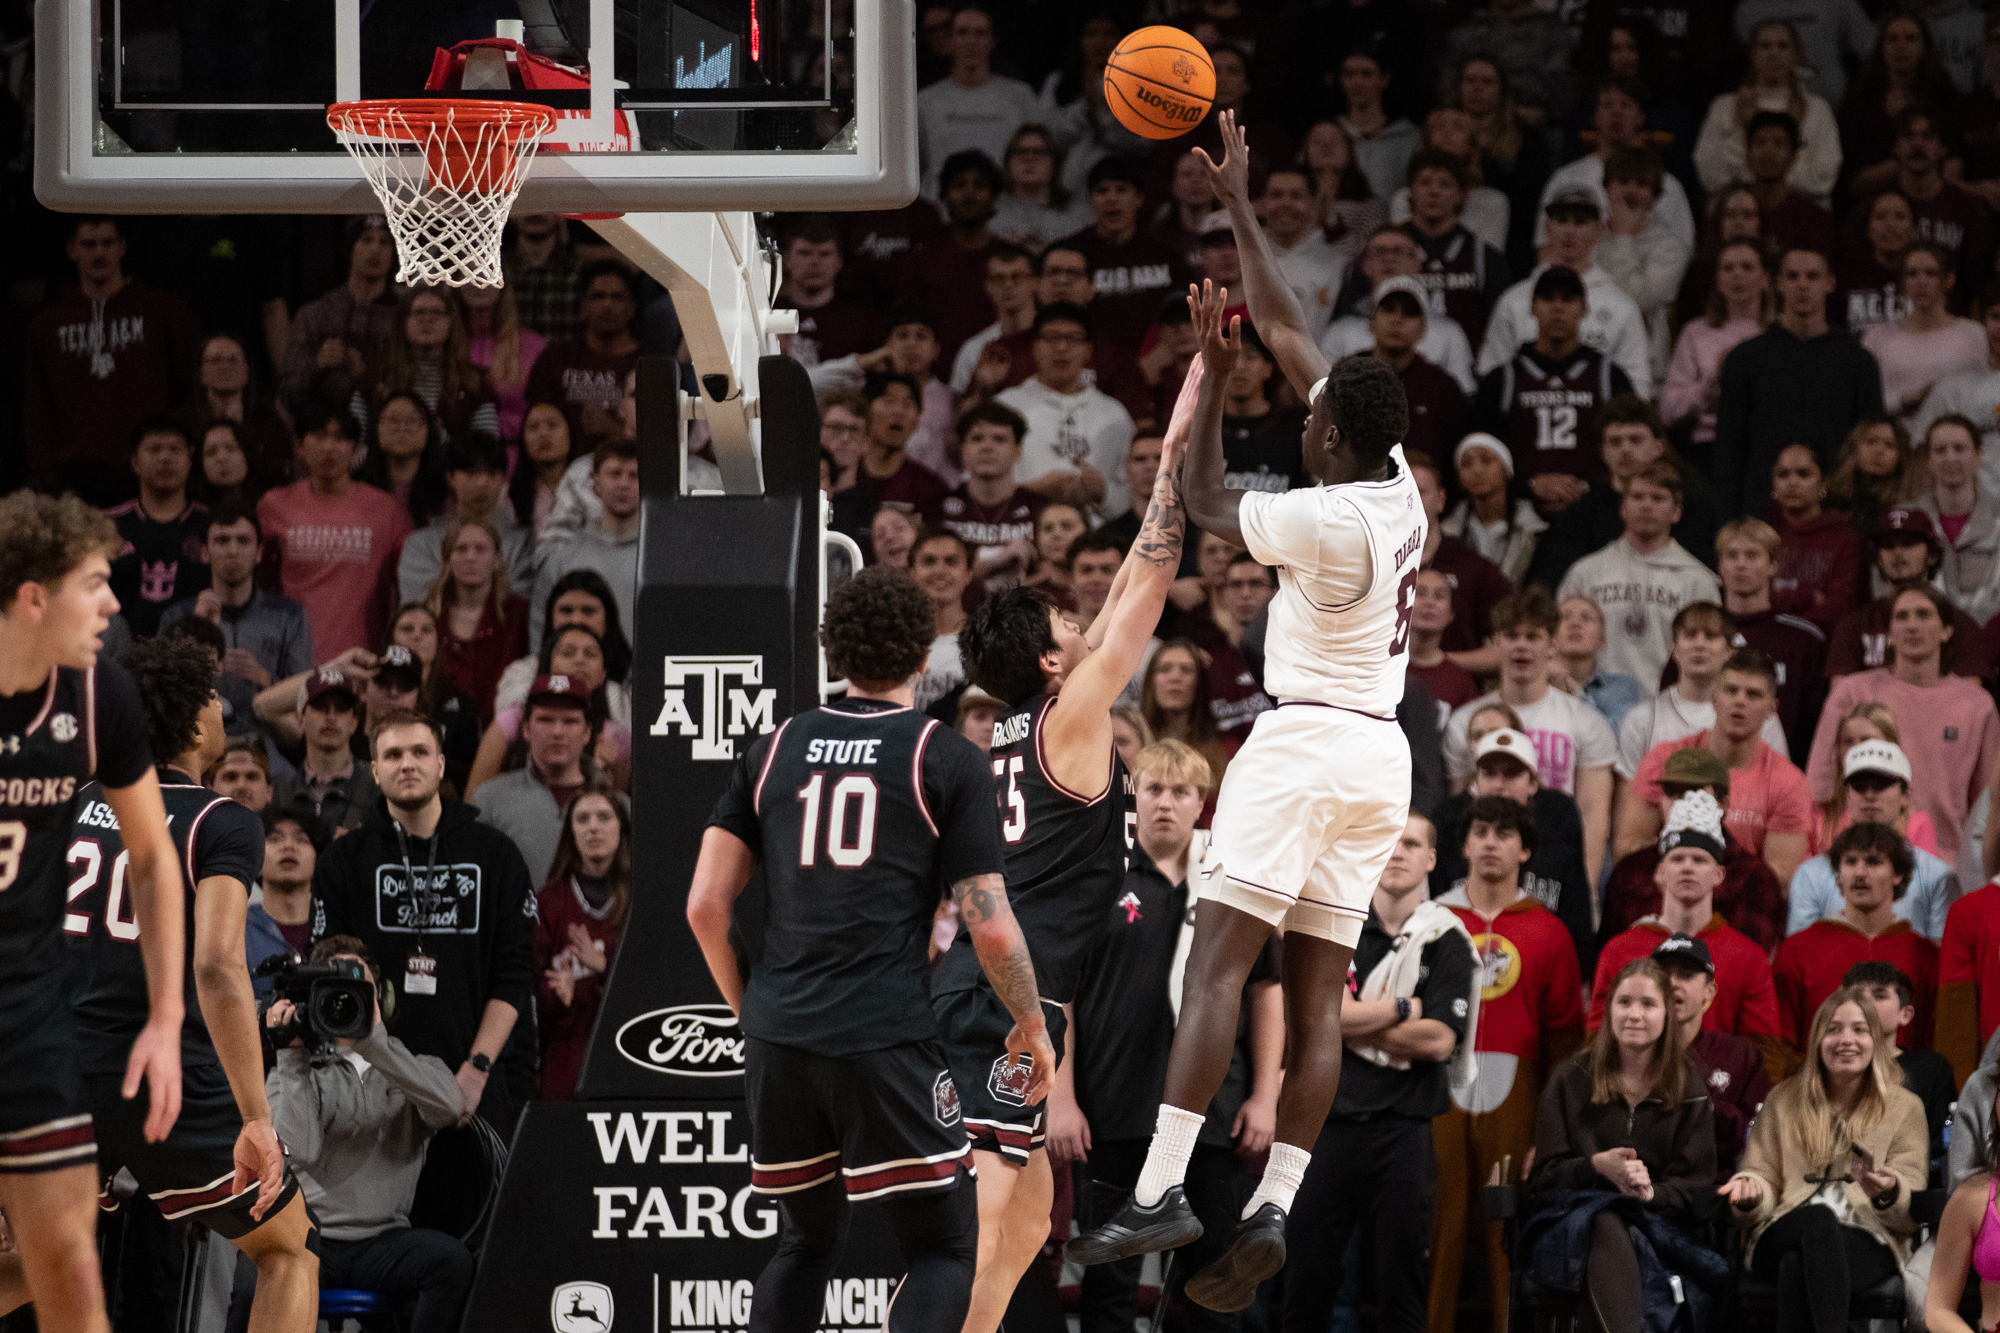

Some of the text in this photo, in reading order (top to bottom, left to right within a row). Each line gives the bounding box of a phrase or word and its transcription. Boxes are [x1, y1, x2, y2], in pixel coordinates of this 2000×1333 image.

[1136, 86, 1202, 122] Wilson
[1537, 406, 1577, 449] 12
[1388, 566, 1418, 656] 6
[806, 738, 882, 764] STUTE
[797, 771, 880, 869] 10
[64, 838, 141, 941] 20
[408, 956, 436, 972] STAFF
[649, 1013, 744, 1064] For
[587, 1111, 753, 1165] WEL
[593, 1186, 780, 1240] FARG
[670, 1277, 889, 1326] KING NCH
